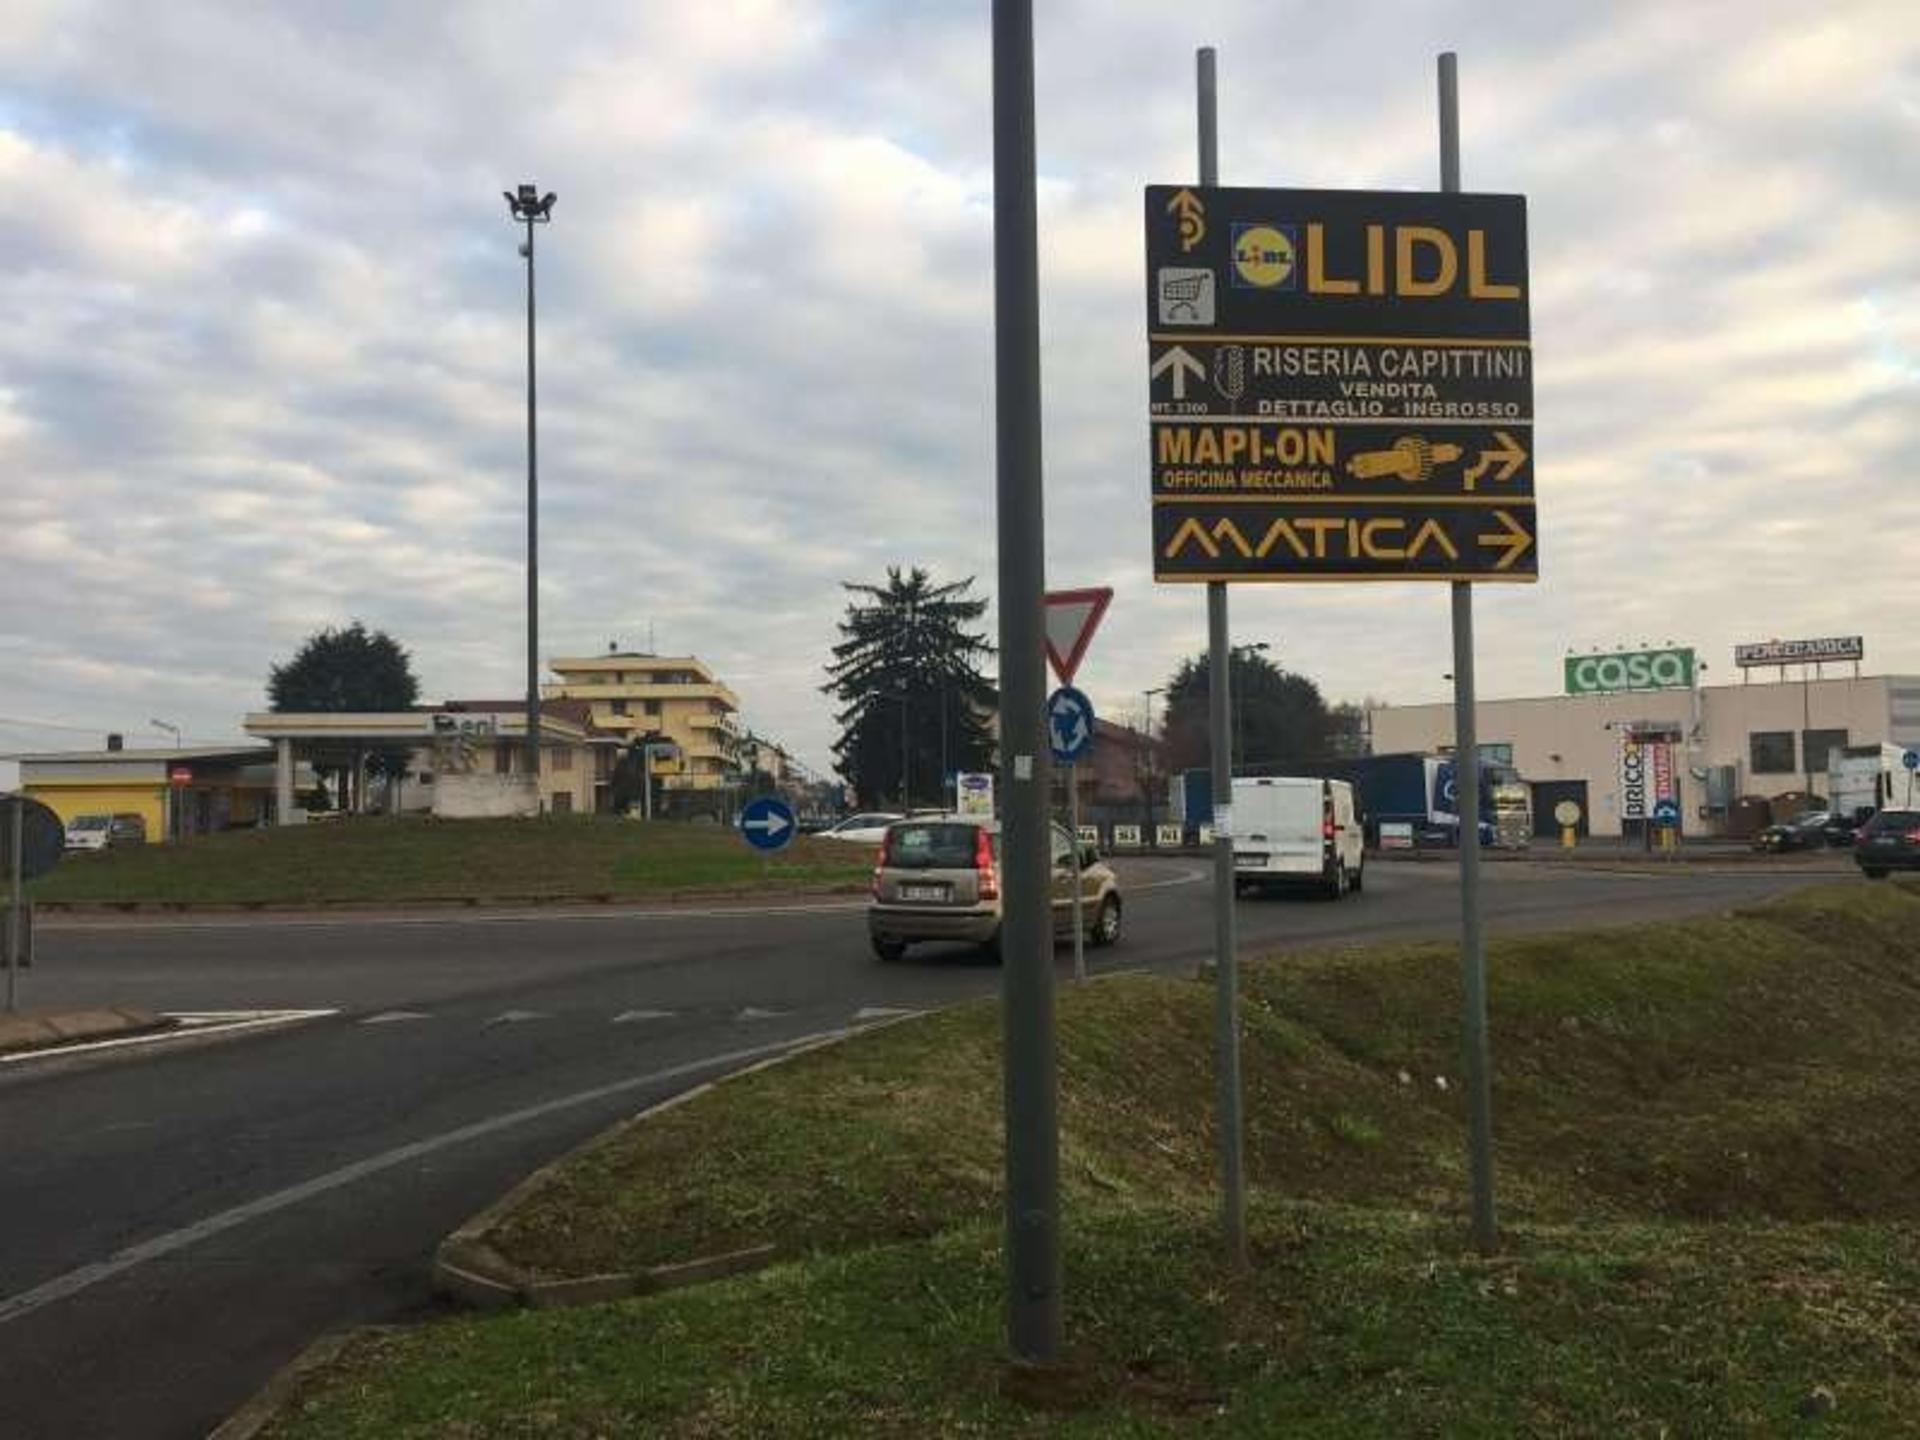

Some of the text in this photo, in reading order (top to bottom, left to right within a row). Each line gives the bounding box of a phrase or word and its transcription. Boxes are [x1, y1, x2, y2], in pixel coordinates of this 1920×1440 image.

[1306, 222, 1521, 299] LIDL
[1253, 346, 1523, 378] RISERIA CAPITTINI
[1339, 382, 1438, 398] VENDITA
[1258, 400, 1383, 416] DETTAGLIO
[1404, 401, 1520, 417] INGROSSO
[1158, 428, 1336, 465] MAPI-ON
[1164, 469, 1333, 488] OFFICINA MECCANICA
[1165, 517, 1459, 559] MATICA
[1574, 653, 1684, 690] casa
